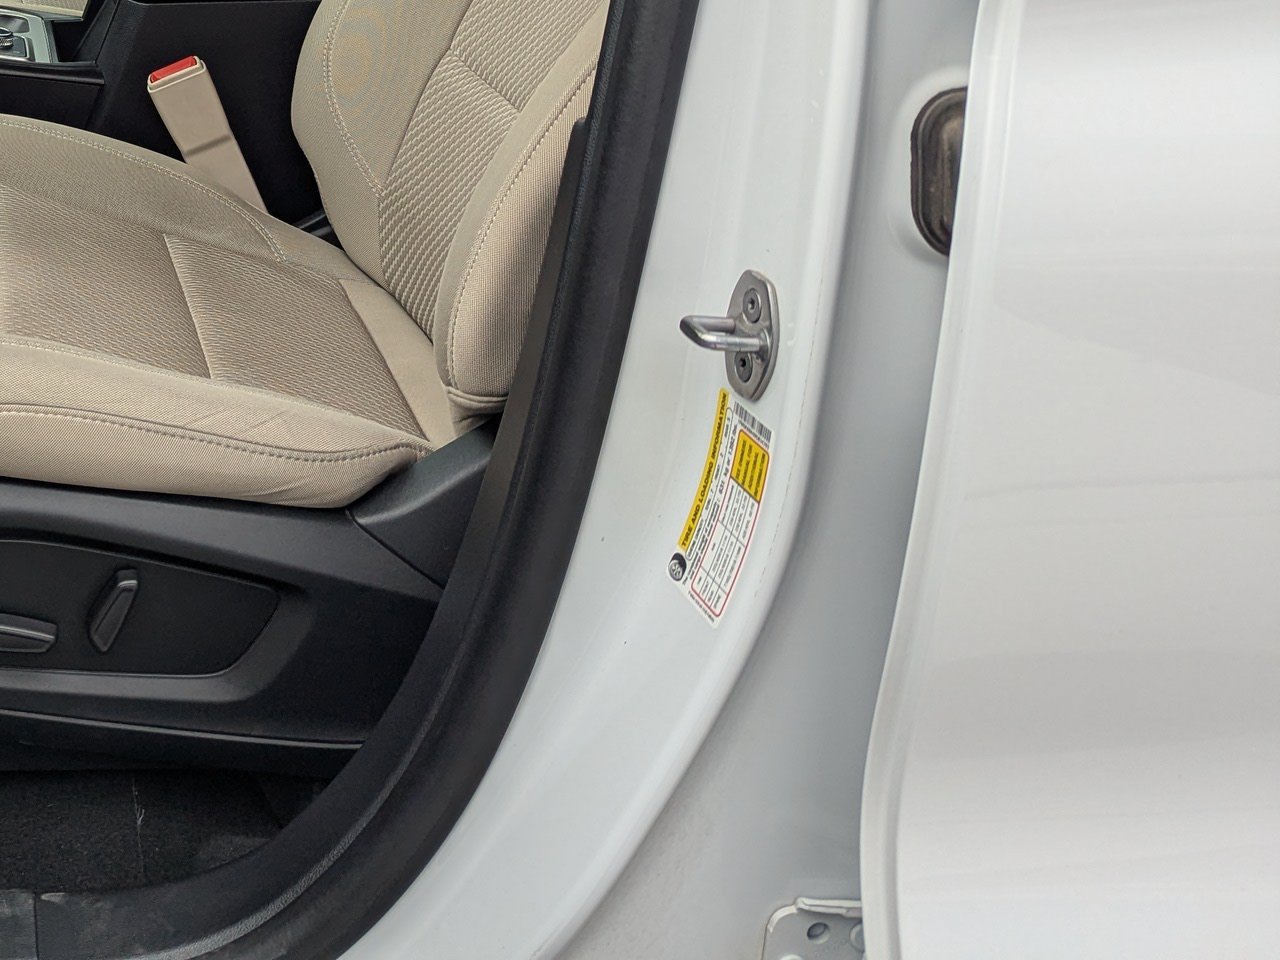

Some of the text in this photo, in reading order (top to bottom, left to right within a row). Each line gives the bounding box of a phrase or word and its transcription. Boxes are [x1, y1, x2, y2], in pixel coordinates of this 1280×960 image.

[681, 392, 726, 546] TIRE AND LOADING INFORMATION
